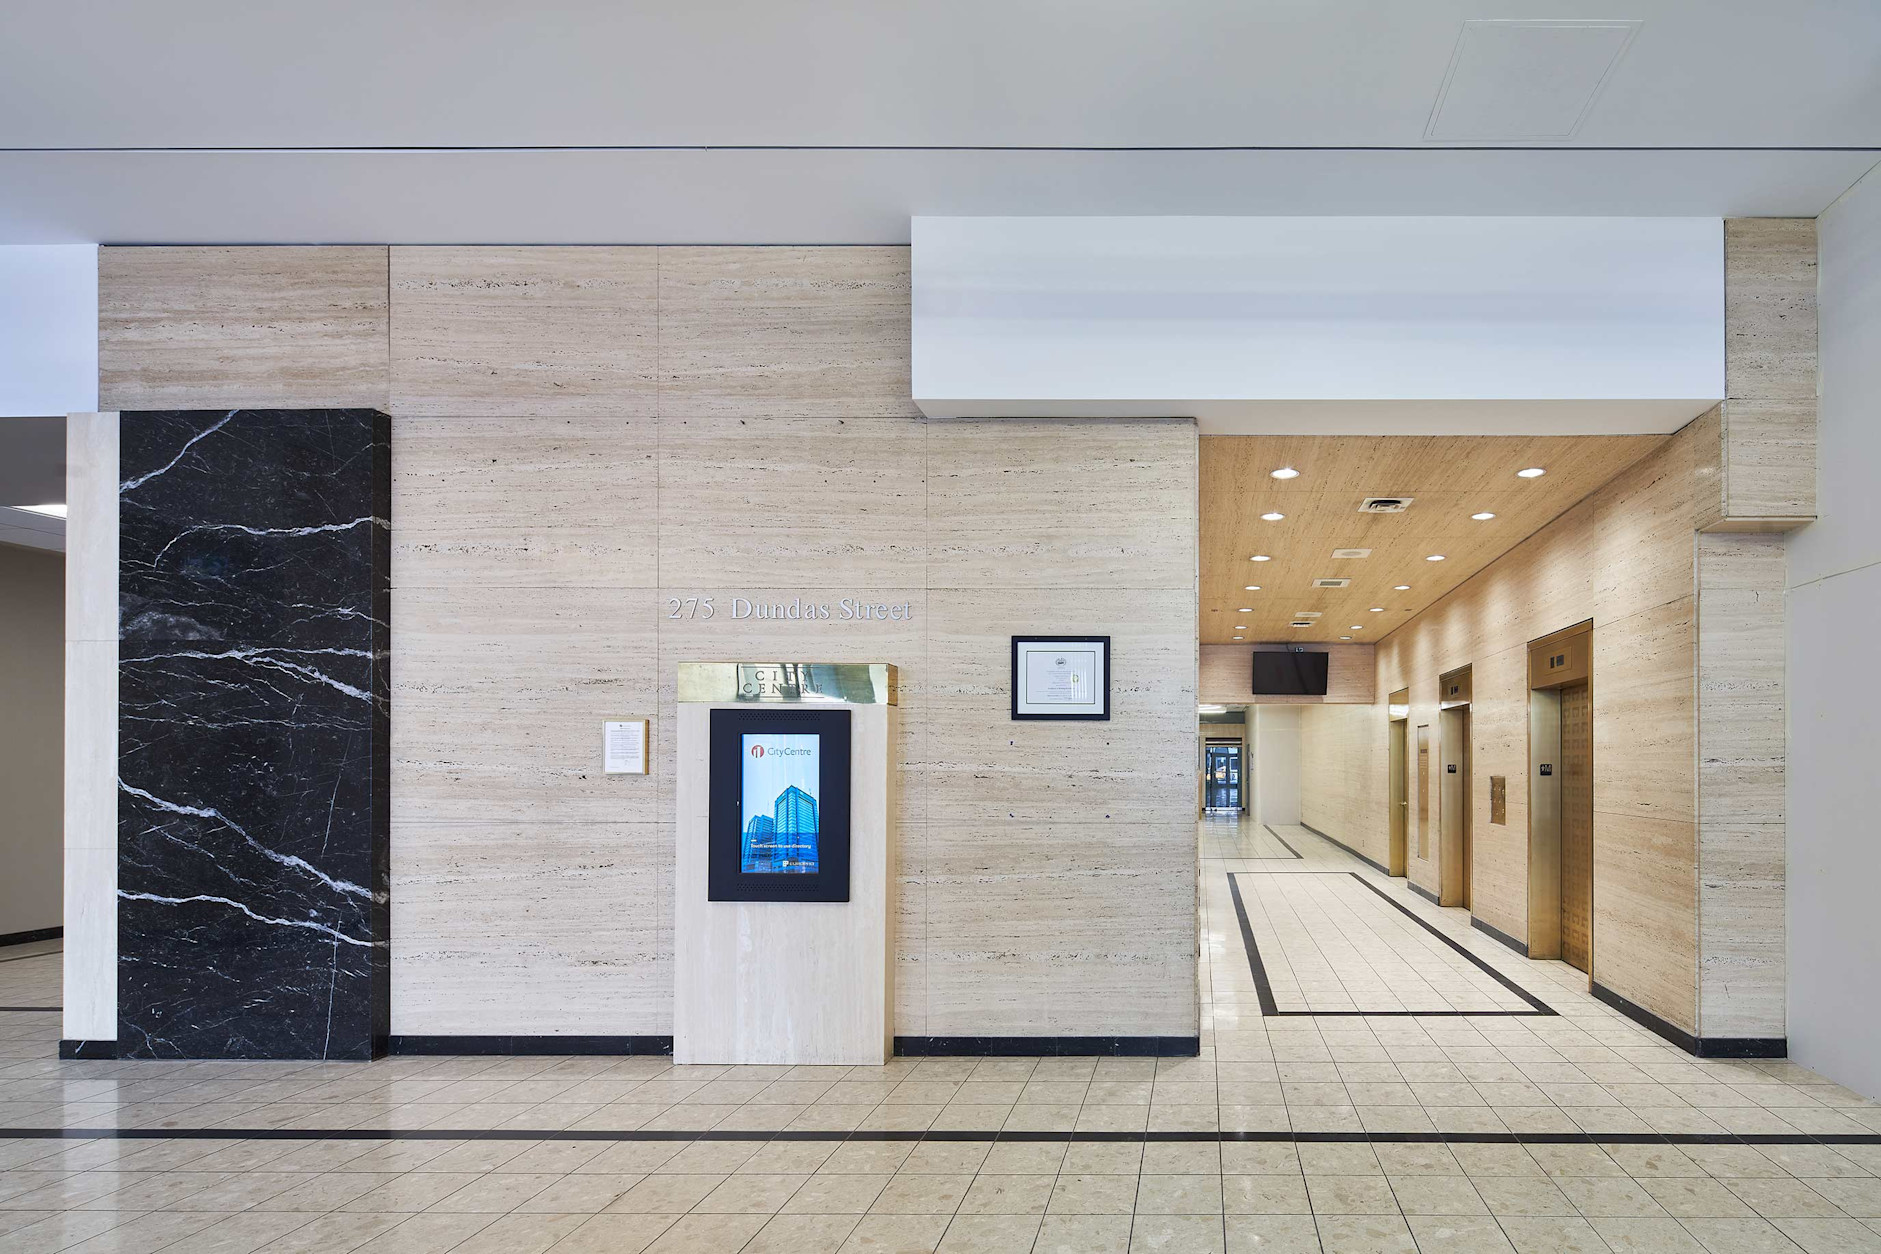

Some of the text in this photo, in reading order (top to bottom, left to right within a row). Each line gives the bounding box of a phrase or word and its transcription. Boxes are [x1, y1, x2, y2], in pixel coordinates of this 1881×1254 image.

[668, 597, 913, 620] 275 Dundas Street
[755, 670, 809, 682] CITY
[767, 747, 811, 758] CityCentre
